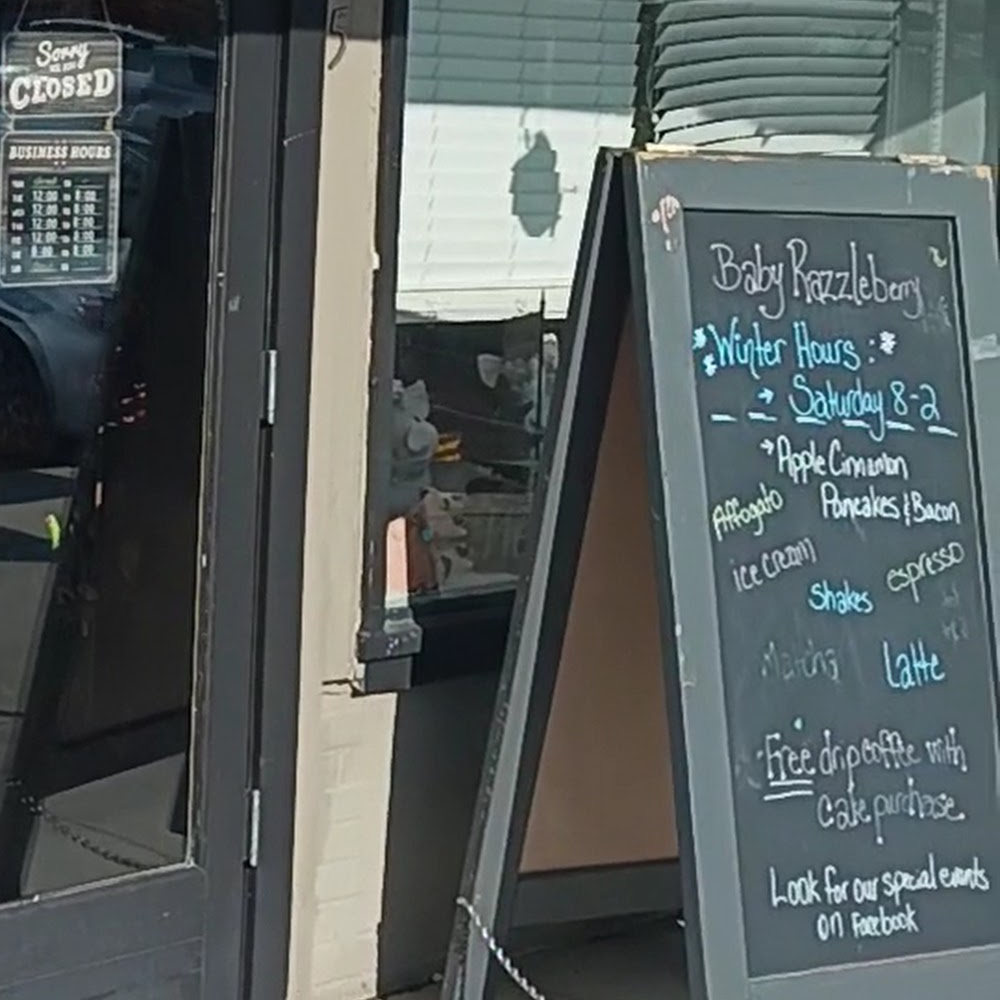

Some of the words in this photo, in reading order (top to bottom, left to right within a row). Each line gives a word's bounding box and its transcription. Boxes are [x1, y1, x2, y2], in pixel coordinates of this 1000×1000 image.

[36, 40, 91, 70] Sorry
[8, 68, 115, 110] CLOSED
[9, 146, 68, 160] BUSINESS
[70, 145, 112, 159] HOURS
[709, 242, 785, 320] Baby
[705, 316, 788, 380] Winter
[788, 373, 886, 442] Saturday
[889, 380, 941, 421] 8-2
[776, 434, 827, 485] Apple
[807, 580, 874, 615] Shakes
[886, 541, 966, 604] espresso
[883, 638, 946, 690] Latte
[765, 731, 817, 782] Free
[818, 728, 861, 793] drip
[924, 726, 969, 773] with
[768, 866, 822, 908] Look
[823, 864, 849, 905] for
[851, 876, 880, 904] our
[880, 852, 938, 907] special
[937, 856, 991, 892] events
